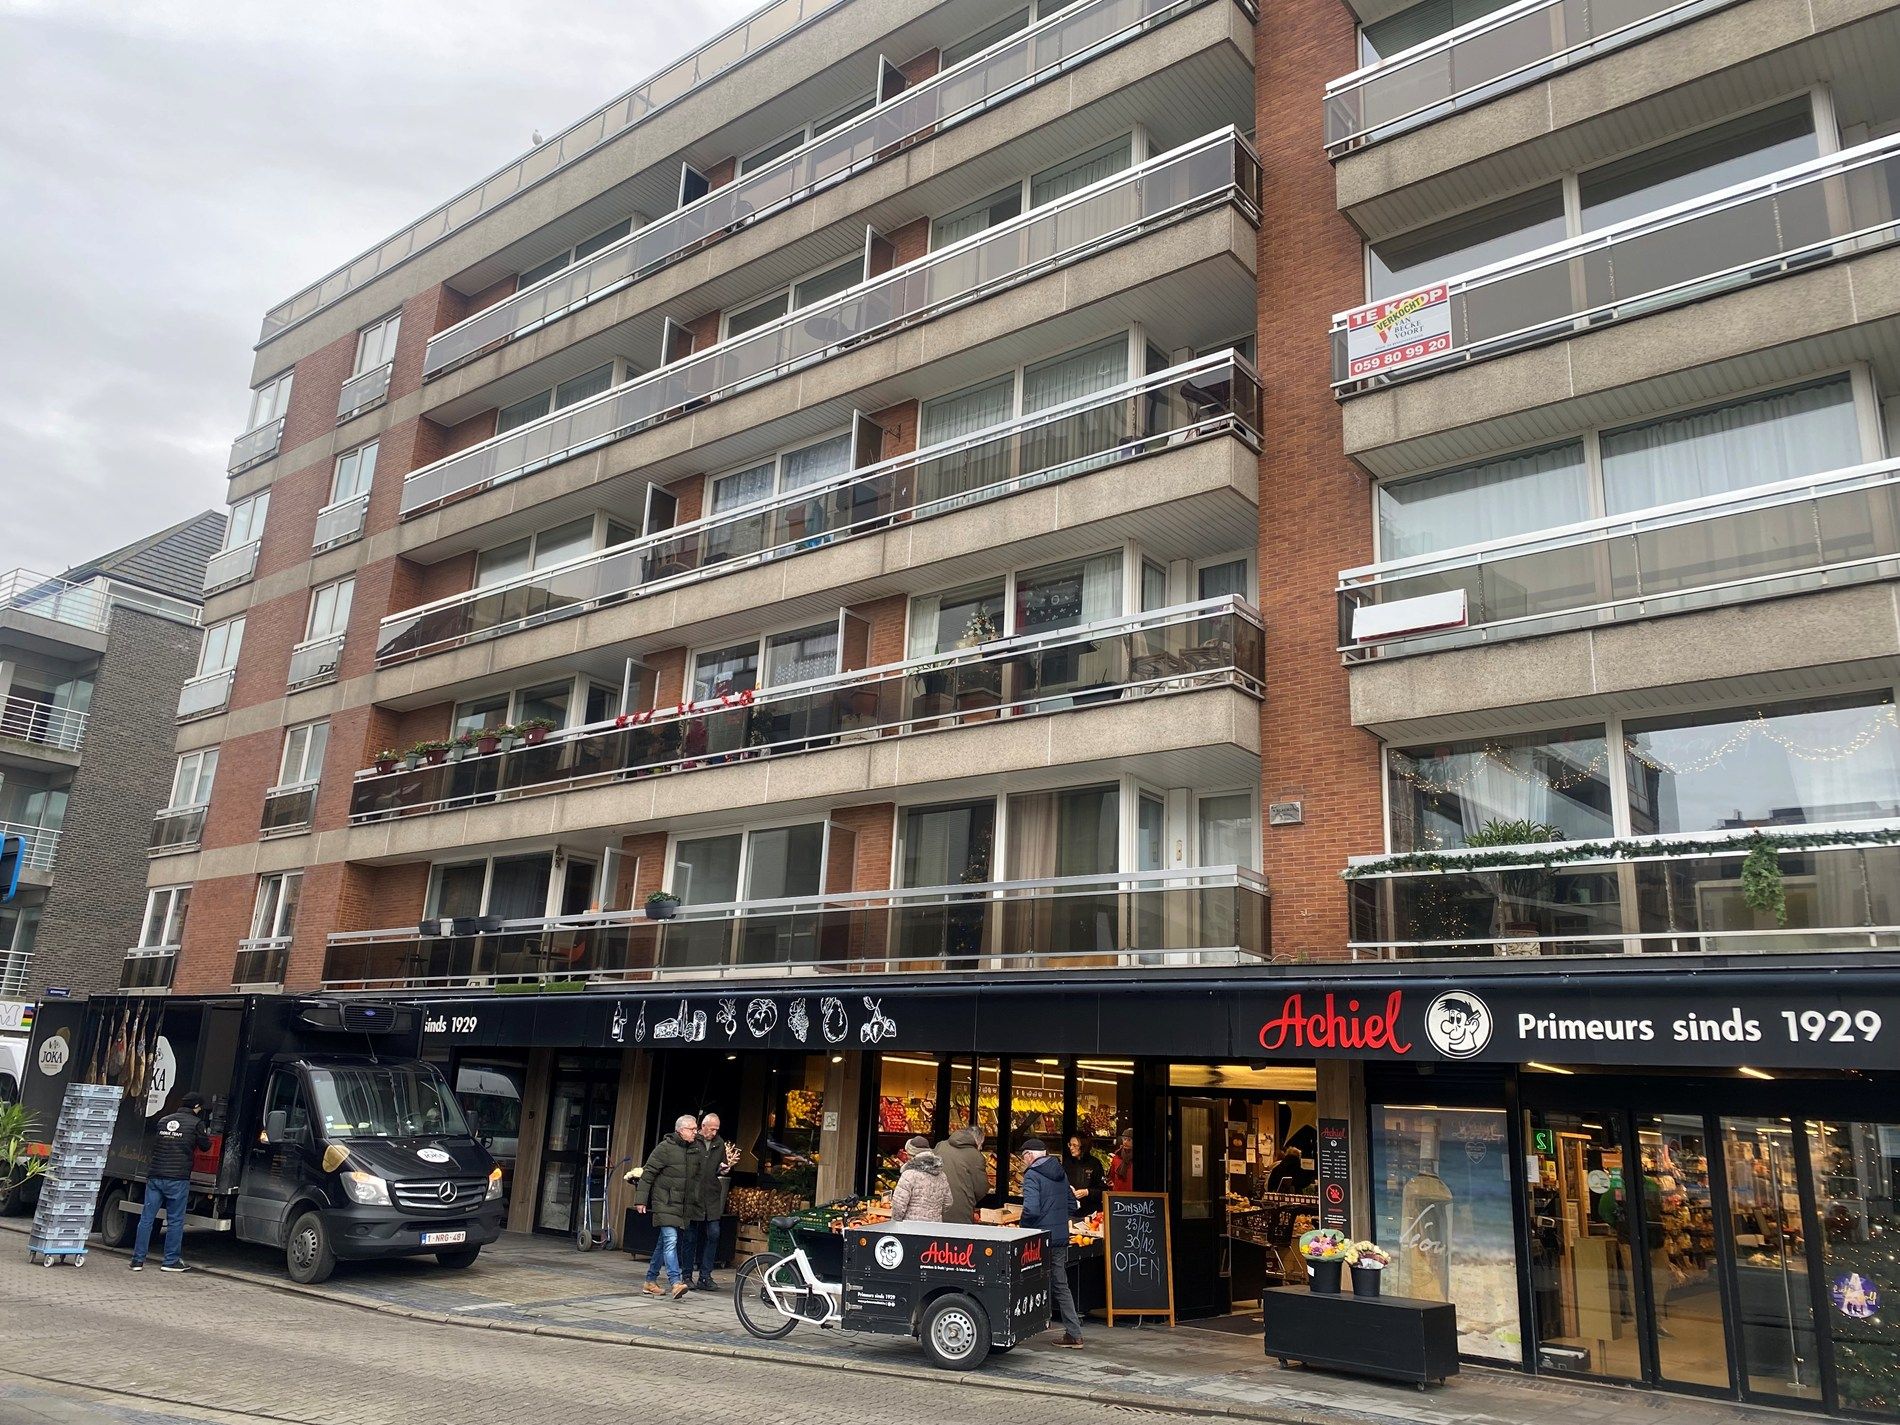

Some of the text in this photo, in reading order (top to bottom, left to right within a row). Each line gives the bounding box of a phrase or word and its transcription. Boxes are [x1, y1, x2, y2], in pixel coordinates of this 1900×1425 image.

[1353, 309, 1378, 325] TE
[1376, 298, 1421, 331] VERKOCHT
[1394, 326, 1424, 339] VOORT
[1354, 357, 1380, 373] 059
[1384, 351, 1402, 365] 80
[1406, 345, 1424, 358] 99
[1428, 338, 1446, 352] 20
[451, 1016, 477, 1033] 1929
[1259, 990, 1412, 1053] Achiel
[1518, 1007, 1882, 1042] Primeurs sinds 1929
[40, 1051, 63, 1064] JOKA
[149, 1067, 166, 1091] KA
[1125, 1217, 1152, 1237] 23/12
[920, 1240, 976, 1268] Achiel
[1020, 1237, 1042, 1267] Achiel
[1124, 1234, 1156, 1254] 30/12
[1114, 1251, 1160, 1286] OPEN
